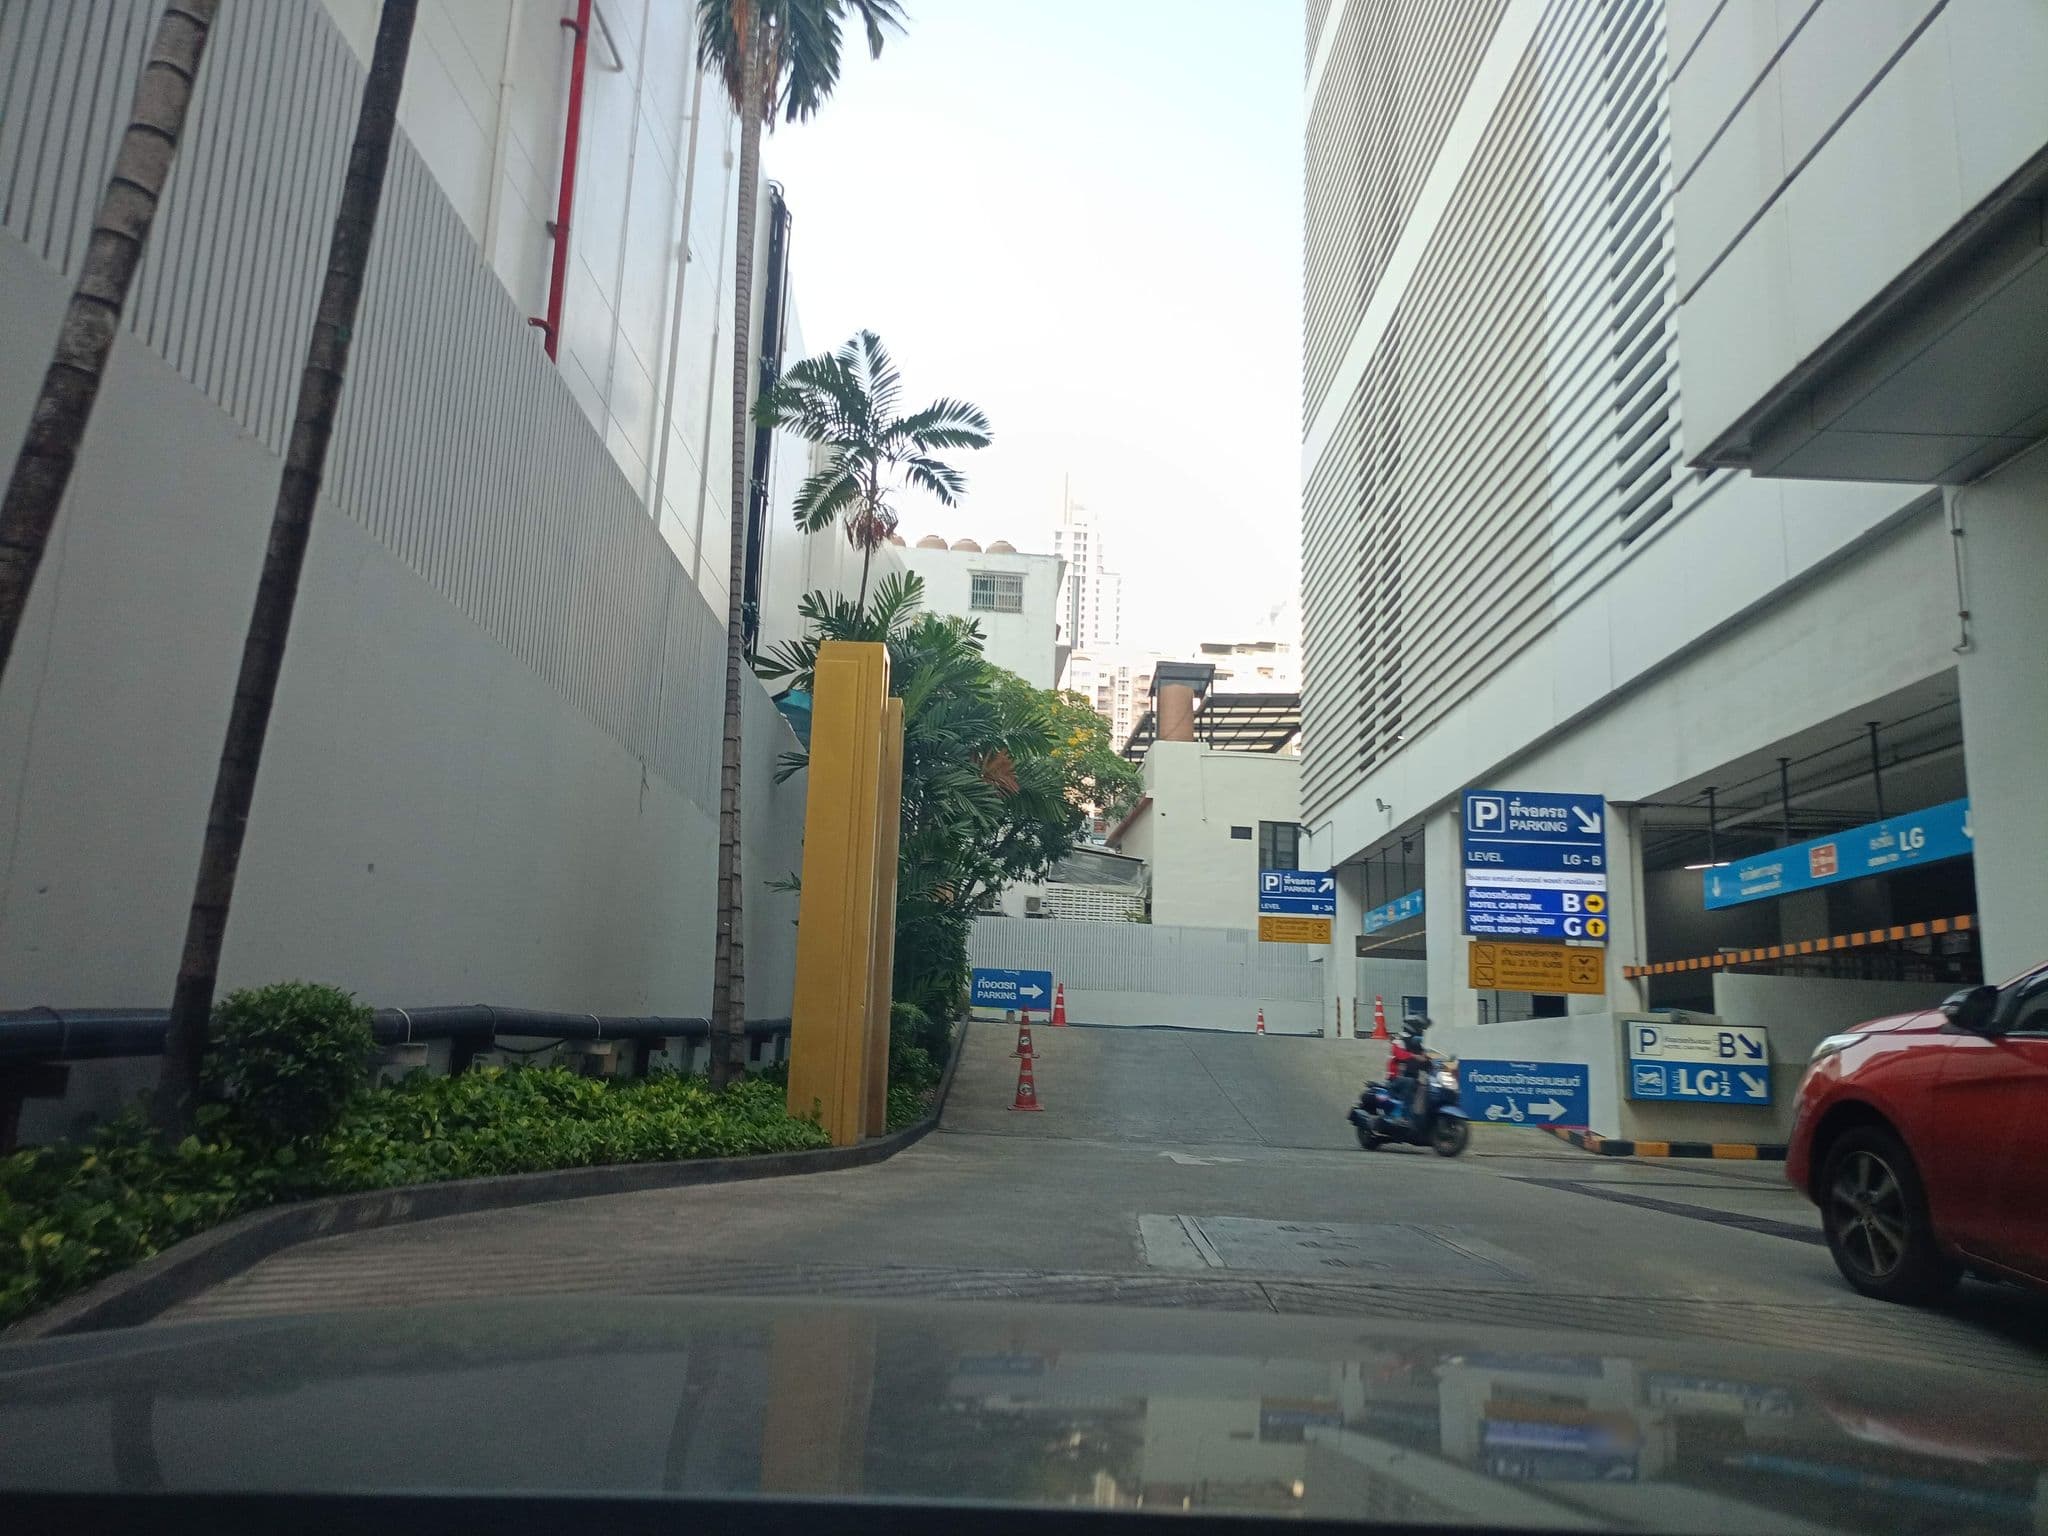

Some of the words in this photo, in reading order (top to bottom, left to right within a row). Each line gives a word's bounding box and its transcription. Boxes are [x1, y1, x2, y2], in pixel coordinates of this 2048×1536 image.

[1475, 801, 1498, 828] P
[1509, 797, 1567, 818] ที่จอดรถ
[1509, 820, 1568, 832] PARKING
[1900, 827, 1925, 851] LG
[1468, 851, 1504, 862] LEVEL
[1563, 854, 1581, 865] LG
[1592, 856, 1602, 866] B
[1265, 875, 1278, 890] P
[1469, 901, 1497, 909] HOTEL
[1498, 902, 1517, 910] CAR
[1518, 903, 1542, 911] PARK
[1562, 893, 1581, 912] B
[1469, 925, 1497, 933] HOTEL
[1498, 926, 1521, 934] DROP
[1521, 927, 1539, 935] OFF
[1563, 917, 1582, 936] G
[977, 976, 1016, 990] ที่จอดรถ
[977, 991, 1016, 1000] PARKING
[1639, 1029, 1657, 1052] P
[1718, 1033, 1736, 1058] B
[1468, 1069, 1581, 1087] ที่จอดรถจักรยานยนต์
[1475, 1085, 1534, 1095] MOTORCYCLE
[1535, 1088, 1574, 1097] PARKING
